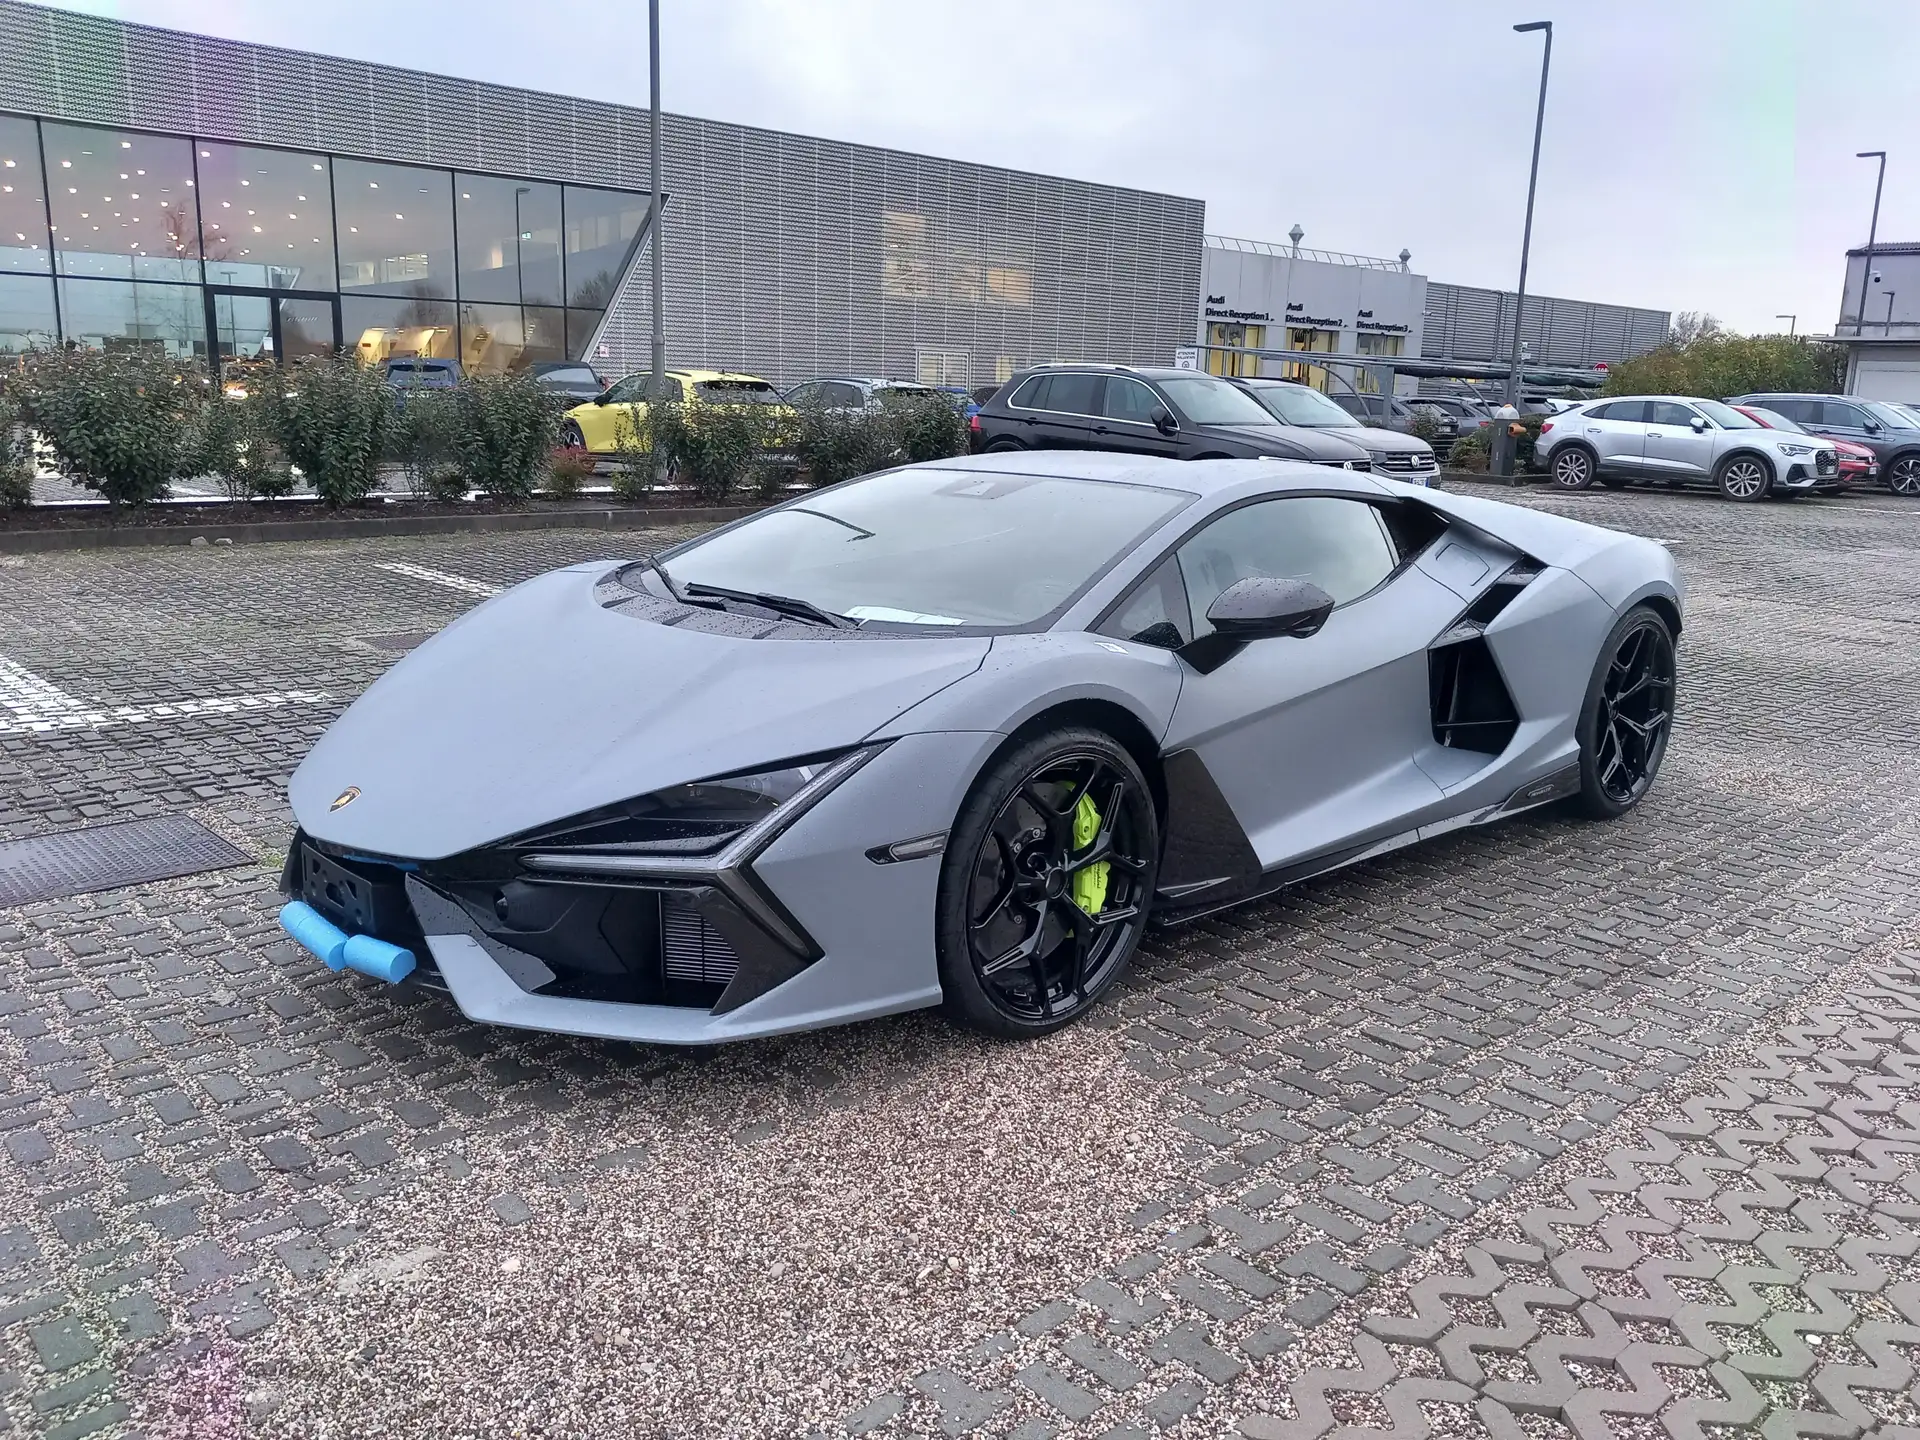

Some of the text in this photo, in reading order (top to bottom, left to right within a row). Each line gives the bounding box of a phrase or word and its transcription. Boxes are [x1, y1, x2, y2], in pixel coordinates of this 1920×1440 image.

[1206, 295, 1225, 304] Audi
[1286, 302, 1303, 311] Audi
[1206, 308, 1228, 317] Direct
[1229, 310, 1264, 321] Reception
[1357, 309, 1373, 317] Audi
[1285, 315, 1305, 323] Direct
[1306, 316, 1338, 326] Reception
[1356, 321, 1374, 329] Direct
[1375, 322, 1403, 332] Reception
